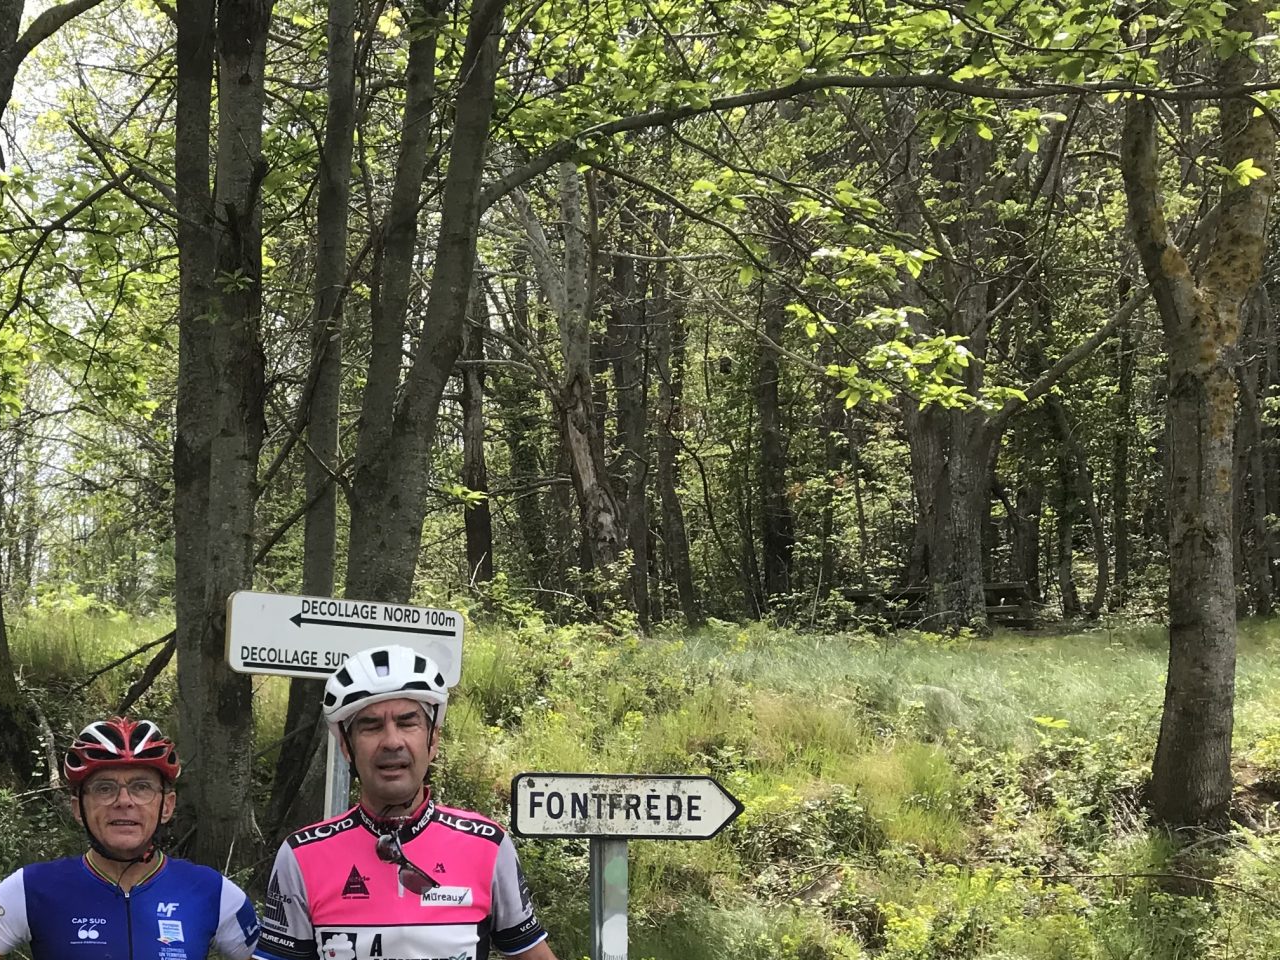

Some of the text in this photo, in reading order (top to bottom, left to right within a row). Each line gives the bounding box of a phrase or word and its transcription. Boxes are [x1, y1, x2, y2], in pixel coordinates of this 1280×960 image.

[300, 599, 456, 628] DECOLLAGE NORD 100m
[240, 645, 318, 666] DECOLLAGE
[529, 788, 702, 821] FONTFRÈDE
[294, 817, 355, 844] LLOYD
[437, 813, 497, 838] LLOYD
[89, 917, 107, 925] SUD
[370, 933, 383, 957] A
